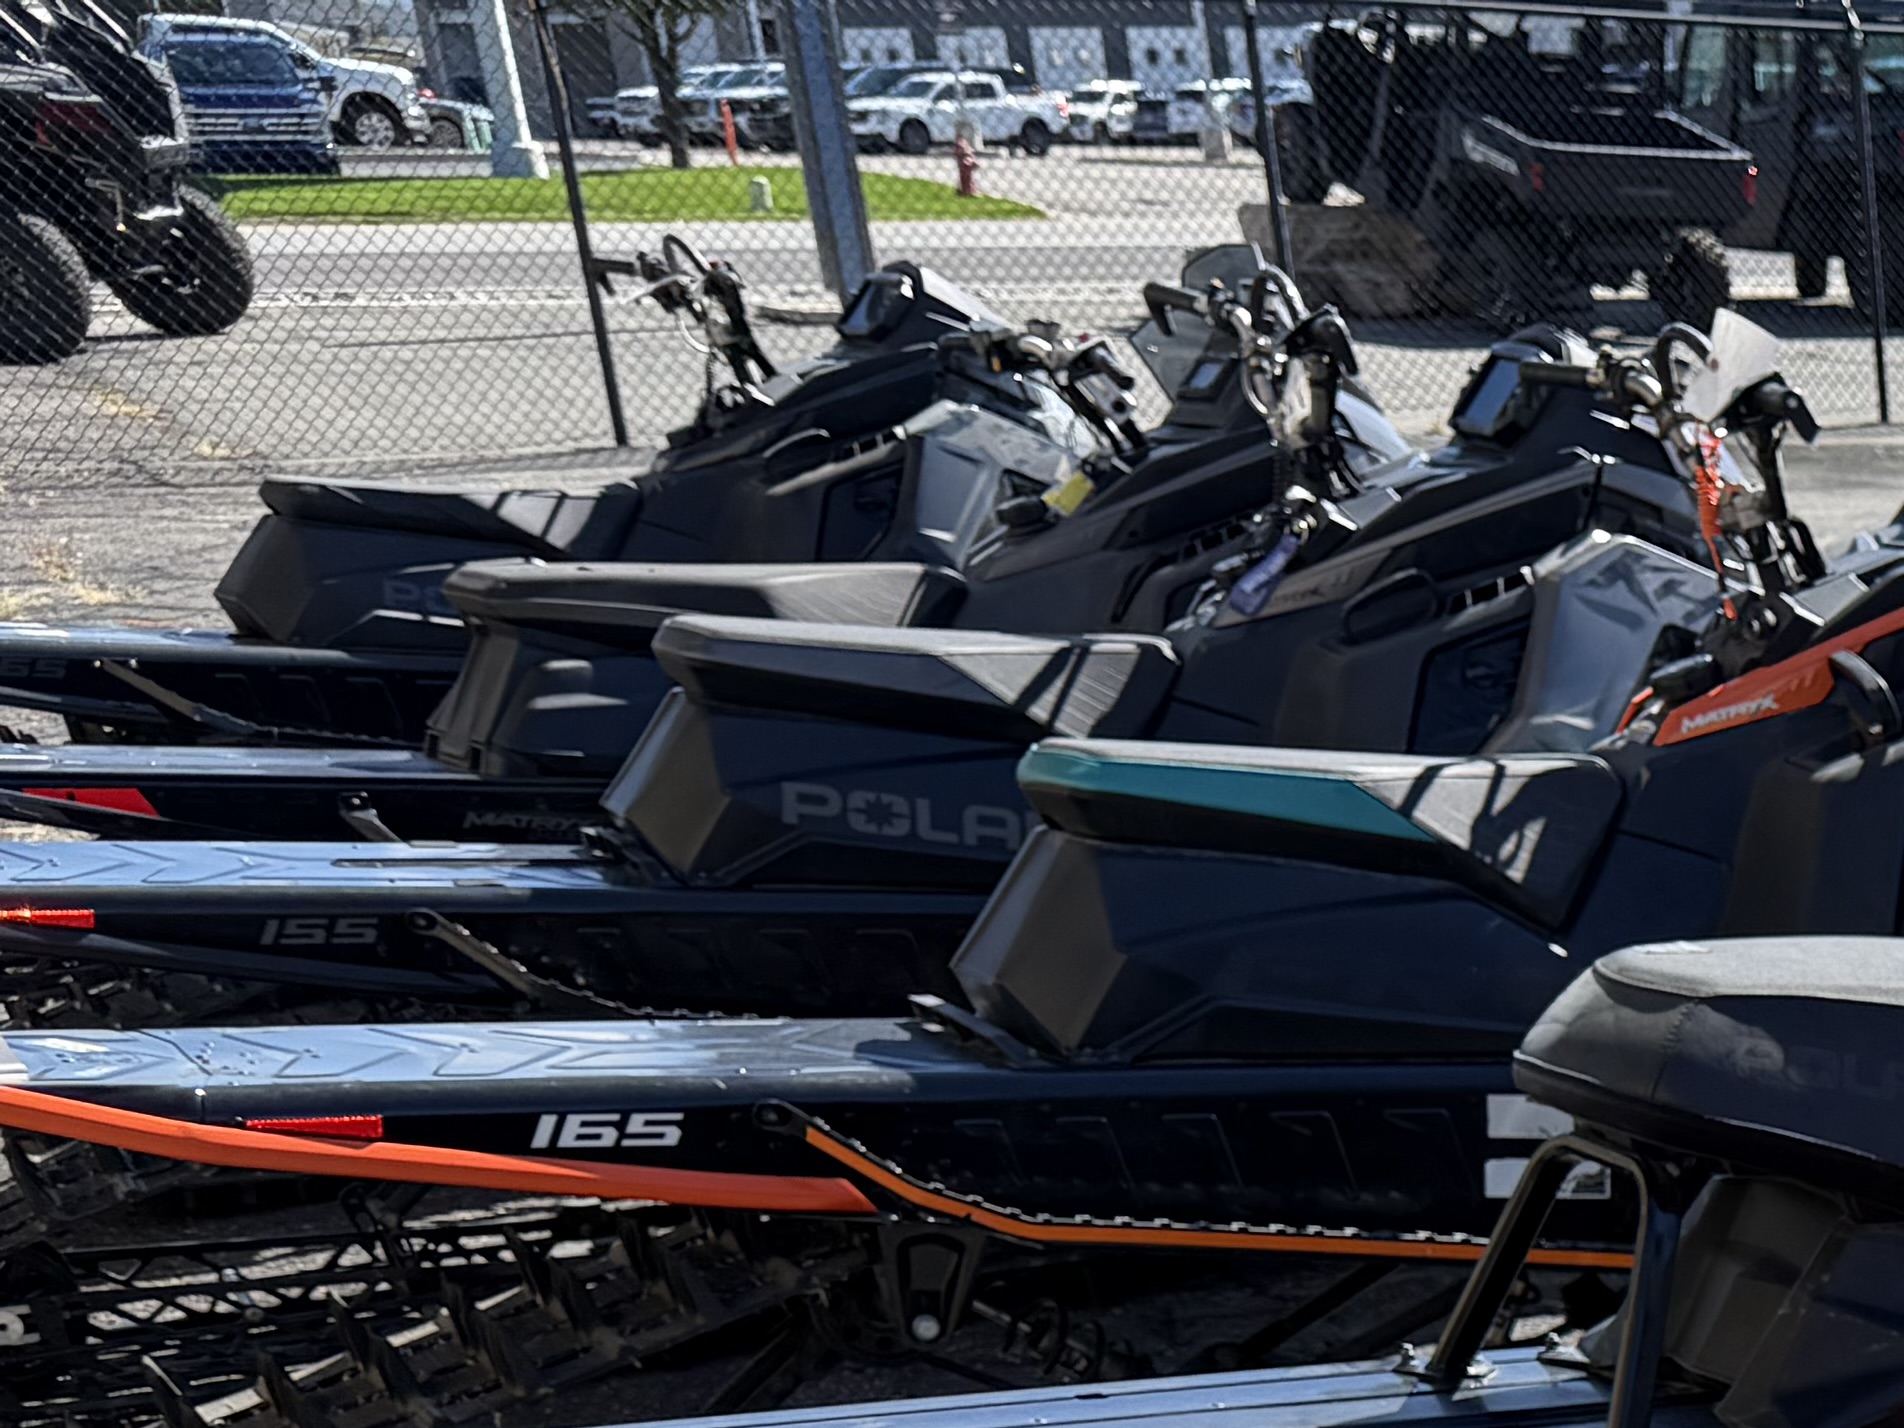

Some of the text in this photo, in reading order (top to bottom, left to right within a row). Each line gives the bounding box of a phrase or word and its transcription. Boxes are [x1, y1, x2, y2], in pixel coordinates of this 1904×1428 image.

[780, 781, 1034, 849] POLA
[260, 917, 380, 946] 155
[530, 1112, 684, 1149] 165
